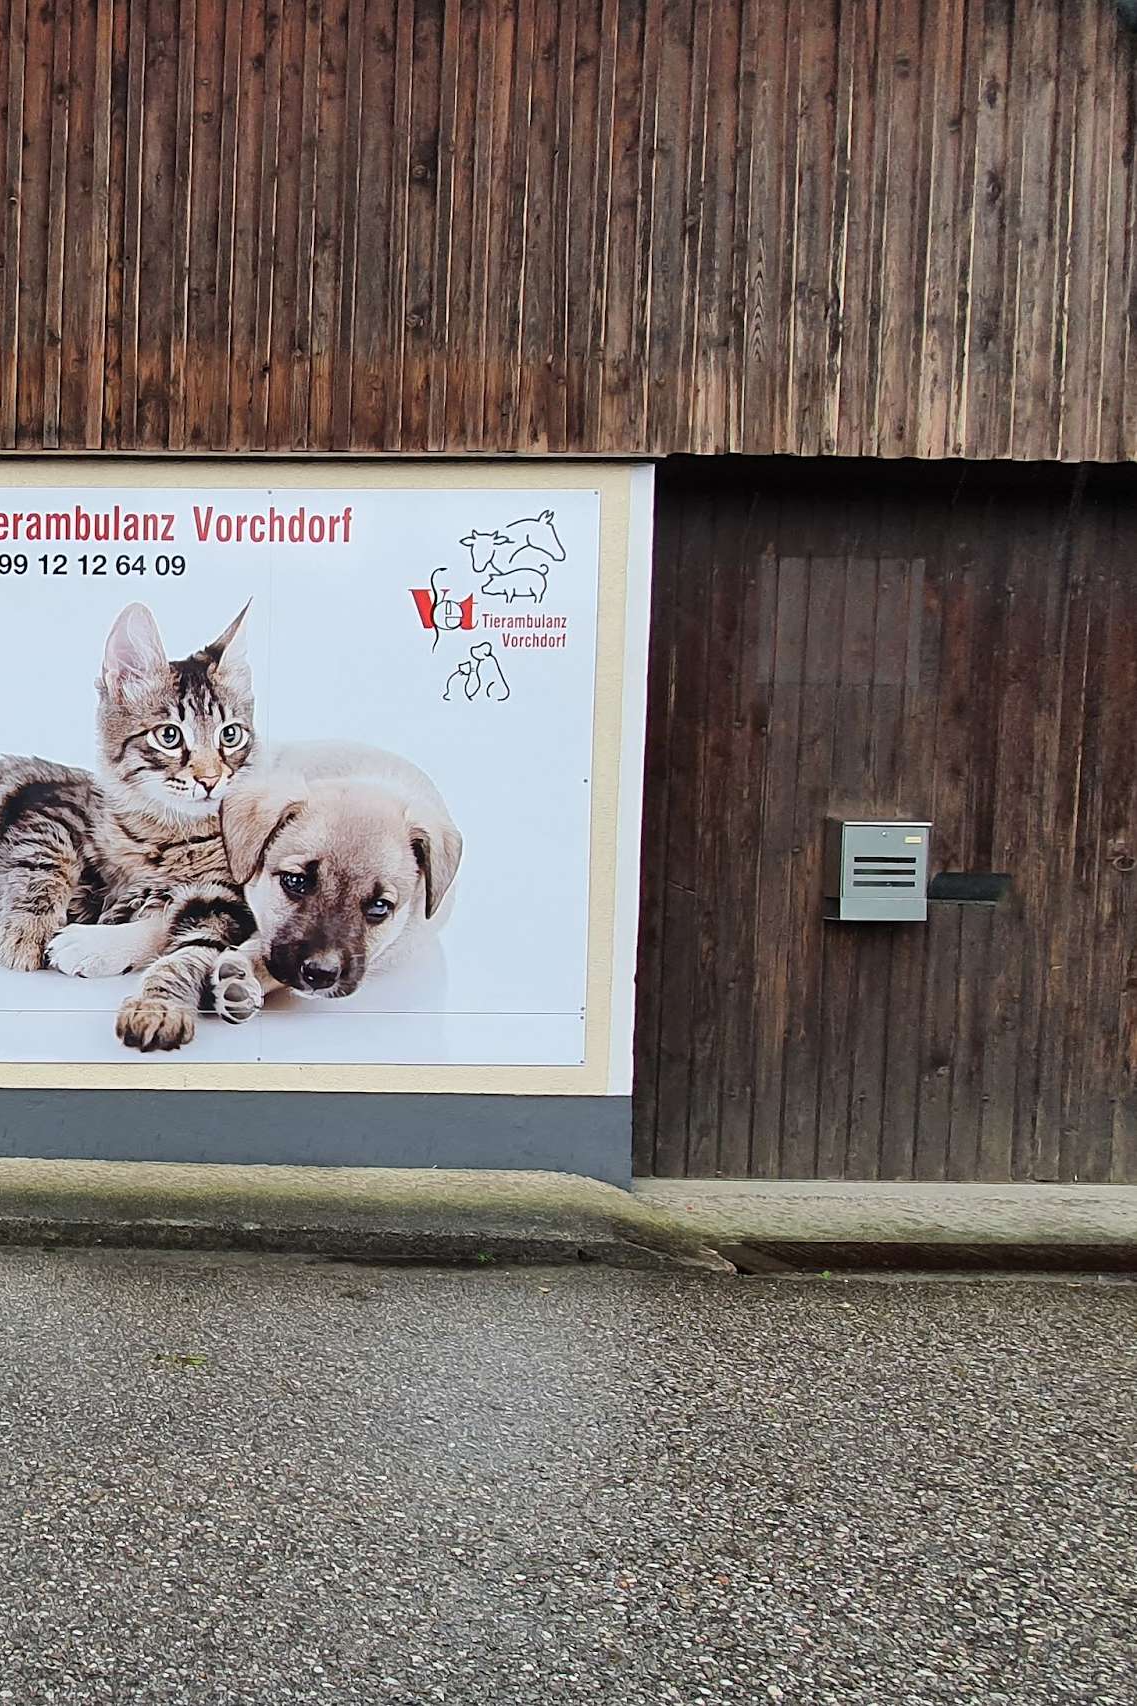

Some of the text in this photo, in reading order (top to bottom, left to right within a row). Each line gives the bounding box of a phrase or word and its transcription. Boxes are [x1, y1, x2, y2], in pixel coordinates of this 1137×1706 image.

[193, 506, 352, 543] Vorchdorf
[38, 552, 67, 575] 12
[78, 552, 108, 575] 12
[116, 555, 147, 575] 64
[155, 555, 185, 576] 09
[483, 614, 566, 629] Tierambulanz
[502, 634, 566, 647] Vorchdorf
